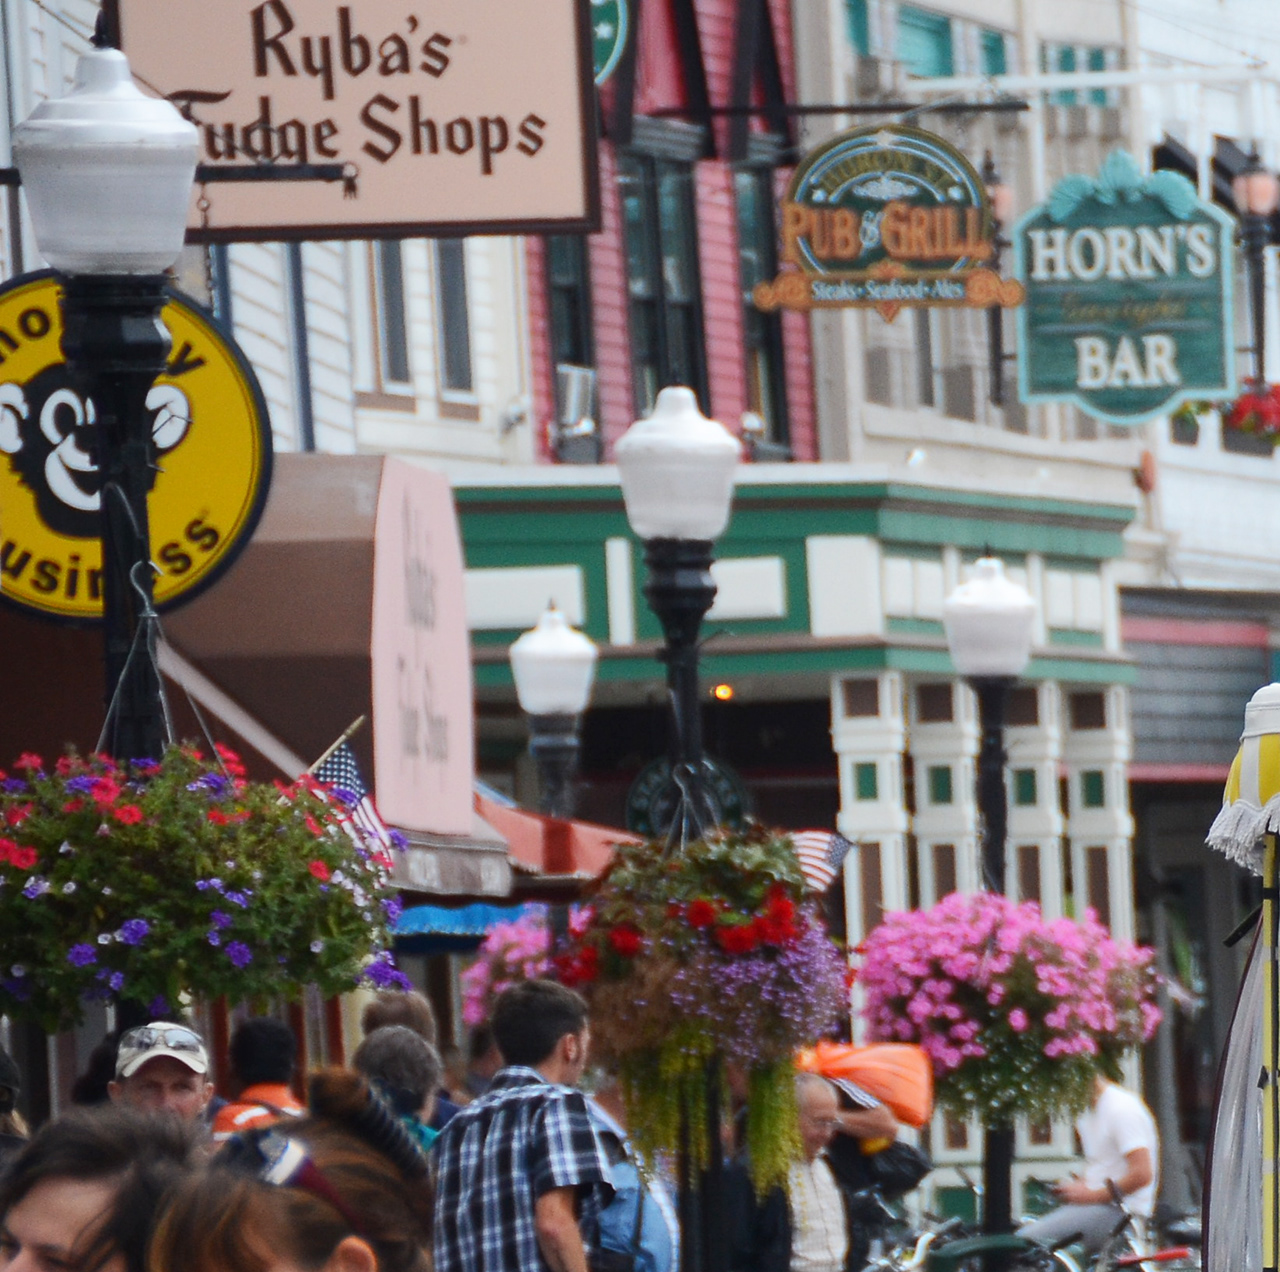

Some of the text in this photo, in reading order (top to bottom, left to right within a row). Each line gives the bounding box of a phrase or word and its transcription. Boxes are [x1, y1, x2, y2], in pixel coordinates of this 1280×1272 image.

[250, 0, 452, 100] Ryba's
[359, 94, 547, 176] Shops
[781, 201, 861, 263] PUB
[881, 200, 992, 260] GRILL
[1028, 223, 1216, 281] HORN'S
[1074, 334, 1182, 389] BAR
